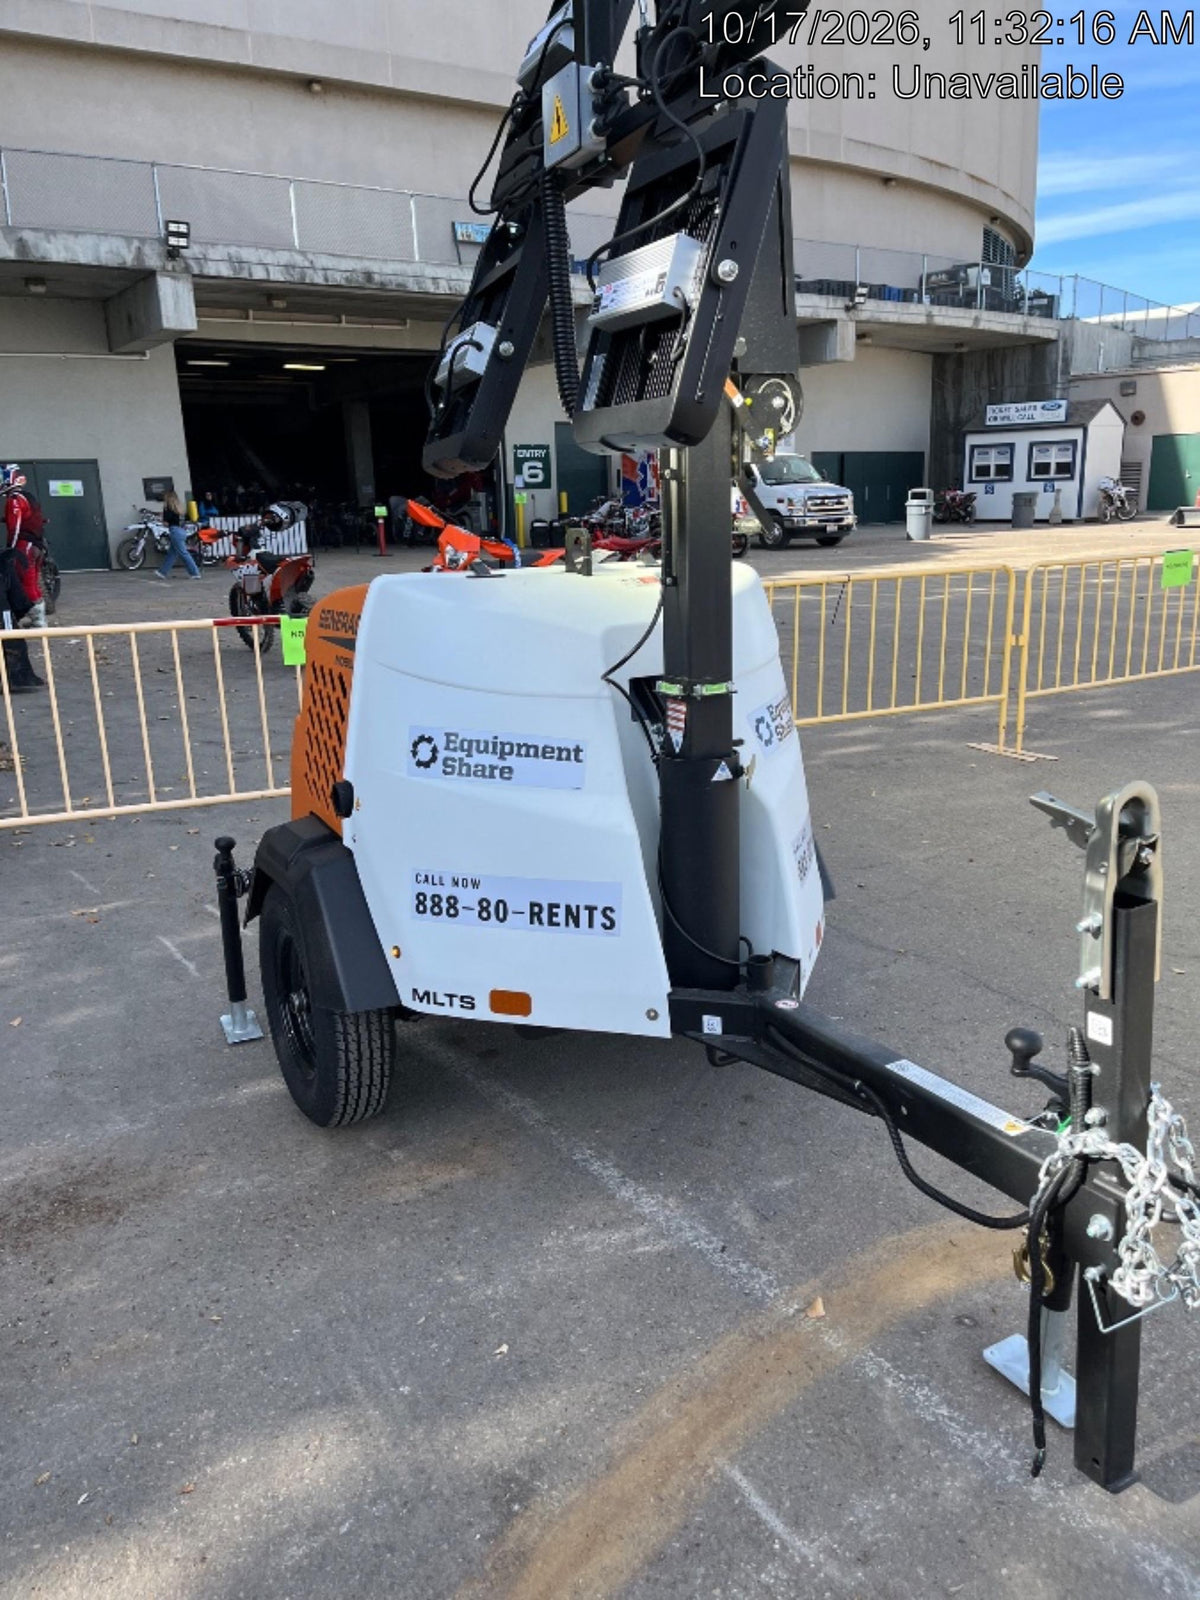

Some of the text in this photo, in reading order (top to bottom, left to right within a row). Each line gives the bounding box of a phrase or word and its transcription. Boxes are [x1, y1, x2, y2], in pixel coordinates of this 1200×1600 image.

[516, 449, 547, 458] ENTRY
[522, 461, 545, 483] 6
[444, 732, 584, 763] Equipment
[442, 756, 514, 780] Share
[415, 872, 481, 890] CALL NOW
[415, 891, 617, 931] 888-80-RENTS
[412, 988, 476, 1011] MLTS
